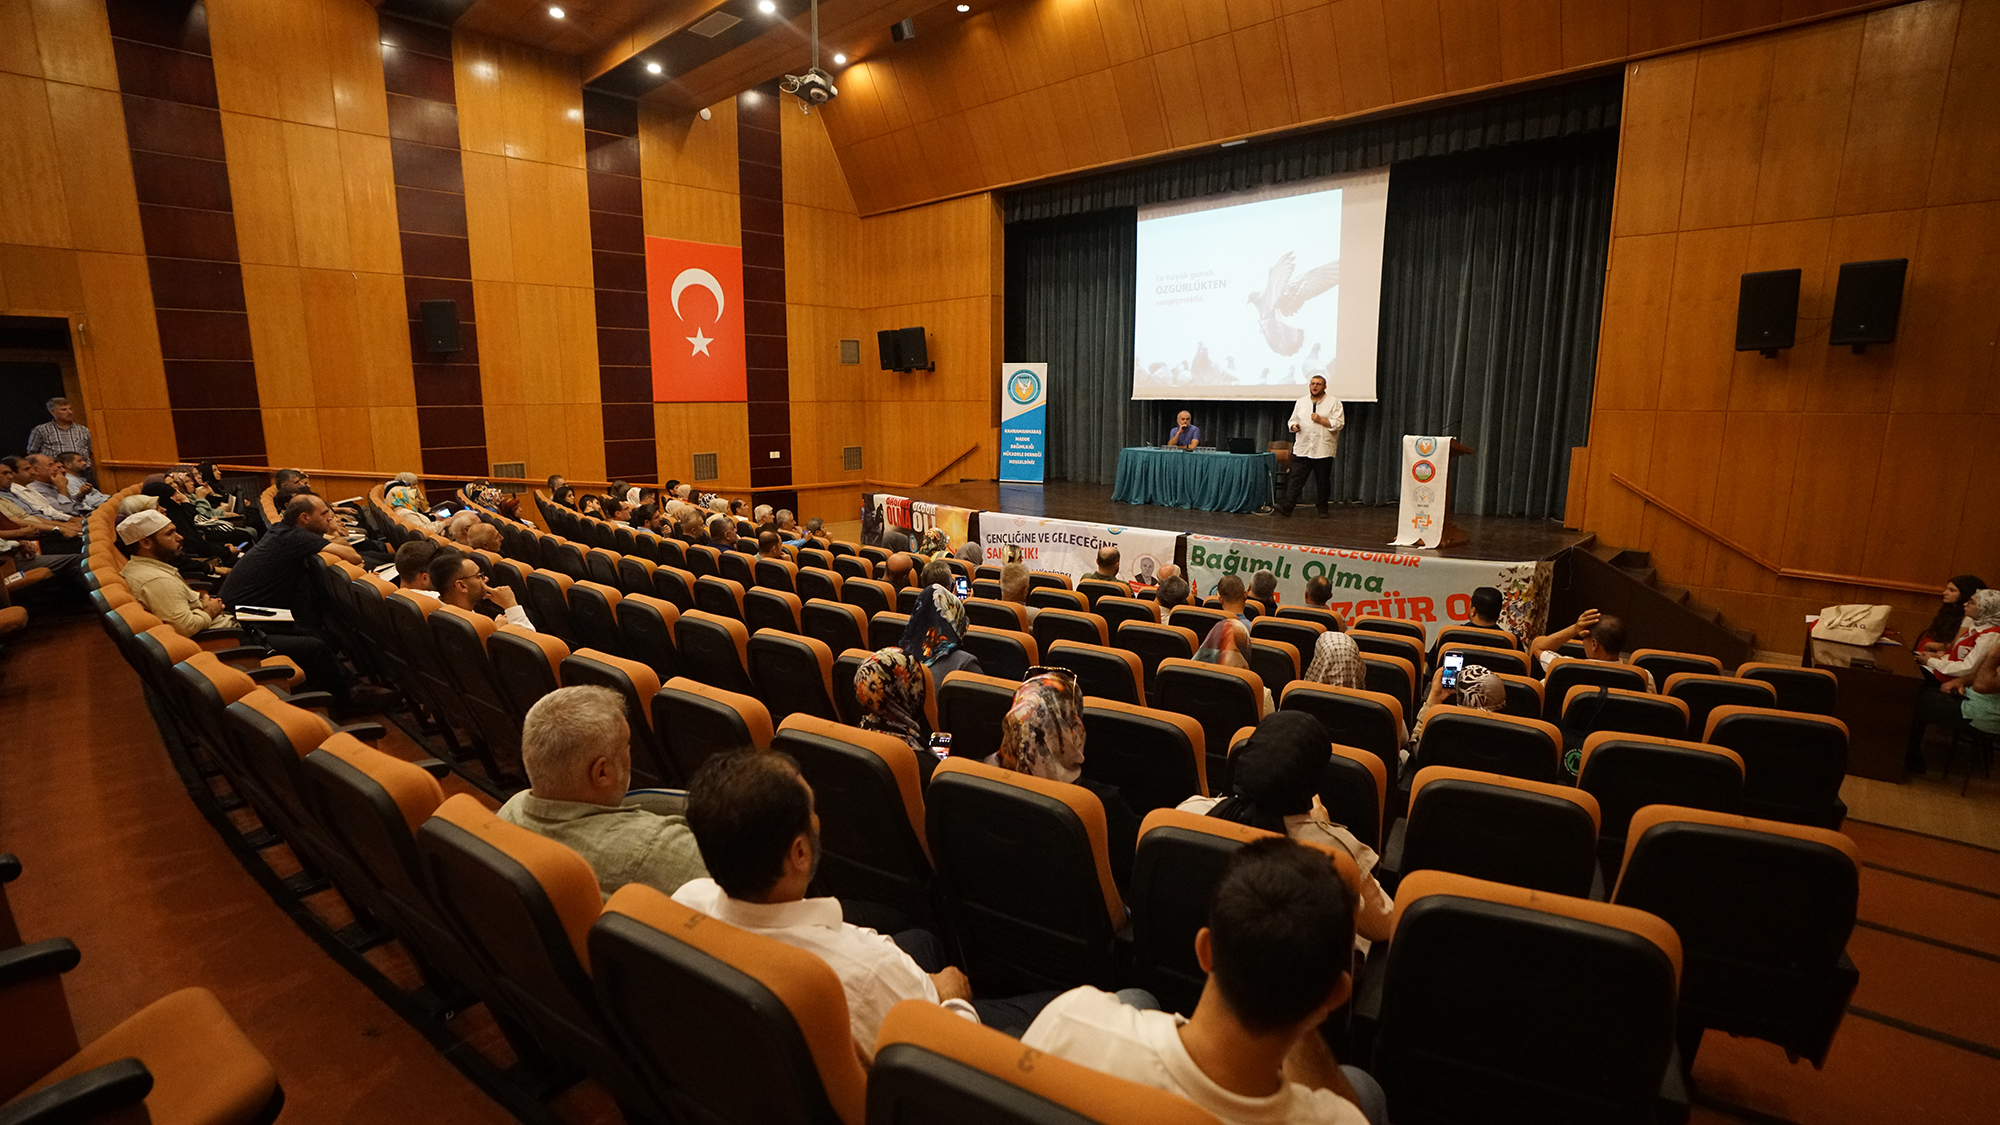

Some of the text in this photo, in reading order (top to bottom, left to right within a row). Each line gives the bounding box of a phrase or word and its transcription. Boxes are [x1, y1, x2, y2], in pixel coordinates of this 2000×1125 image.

[1155, 279, 1227, 295] ÖZGÜRLÜKTEN
[1156, 274, 1165, 282] En
[1166, 271, 1188, 282] büyük
[886, 506, 912, 530] OLMA
[1038, 532, 1050, 543] VE
[1190, 545, 1292, 579] Bağımlı
[1302, 560, 1384, 593] Olma
[1326, 590, 1437, 626] ZGÜR
